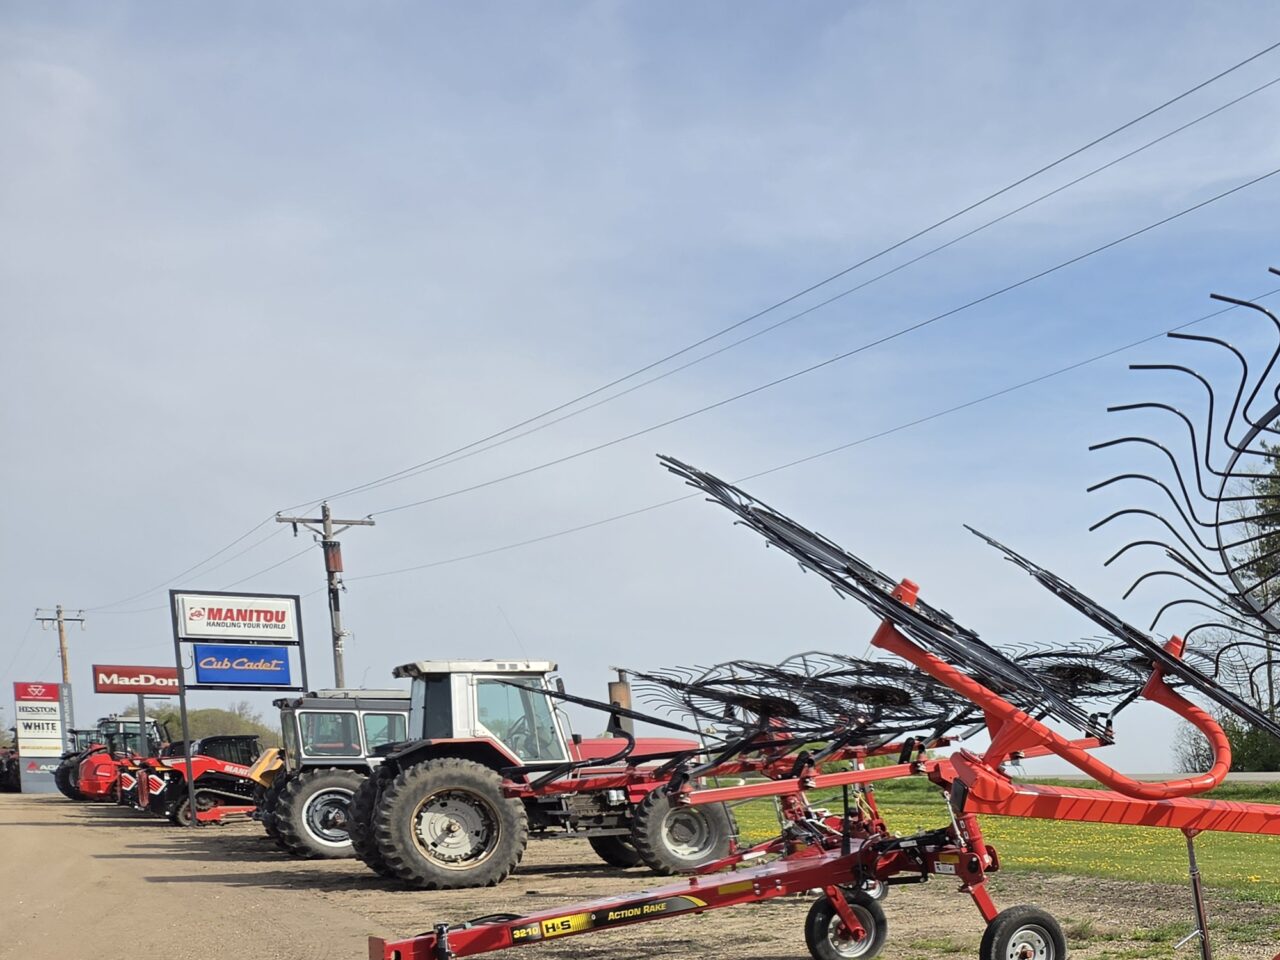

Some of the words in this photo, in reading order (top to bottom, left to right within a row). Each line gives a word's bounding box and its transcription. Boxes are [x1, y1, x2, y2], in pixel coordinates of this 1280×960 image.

[207, 608, 286, 623] MANITOU
[199, 657, 231, 669] Cub
[232, 658, 284, 671] Cadet
[98, 673, 178, 686] MacDon
[22, 722, 57, 731] WHITE
[513, 927, 539, 939] 3210
[544, 919, 571, 933] H&S
[608, 908, 641, 921] ACTION
[643, 902, 667, 914] RAKE
